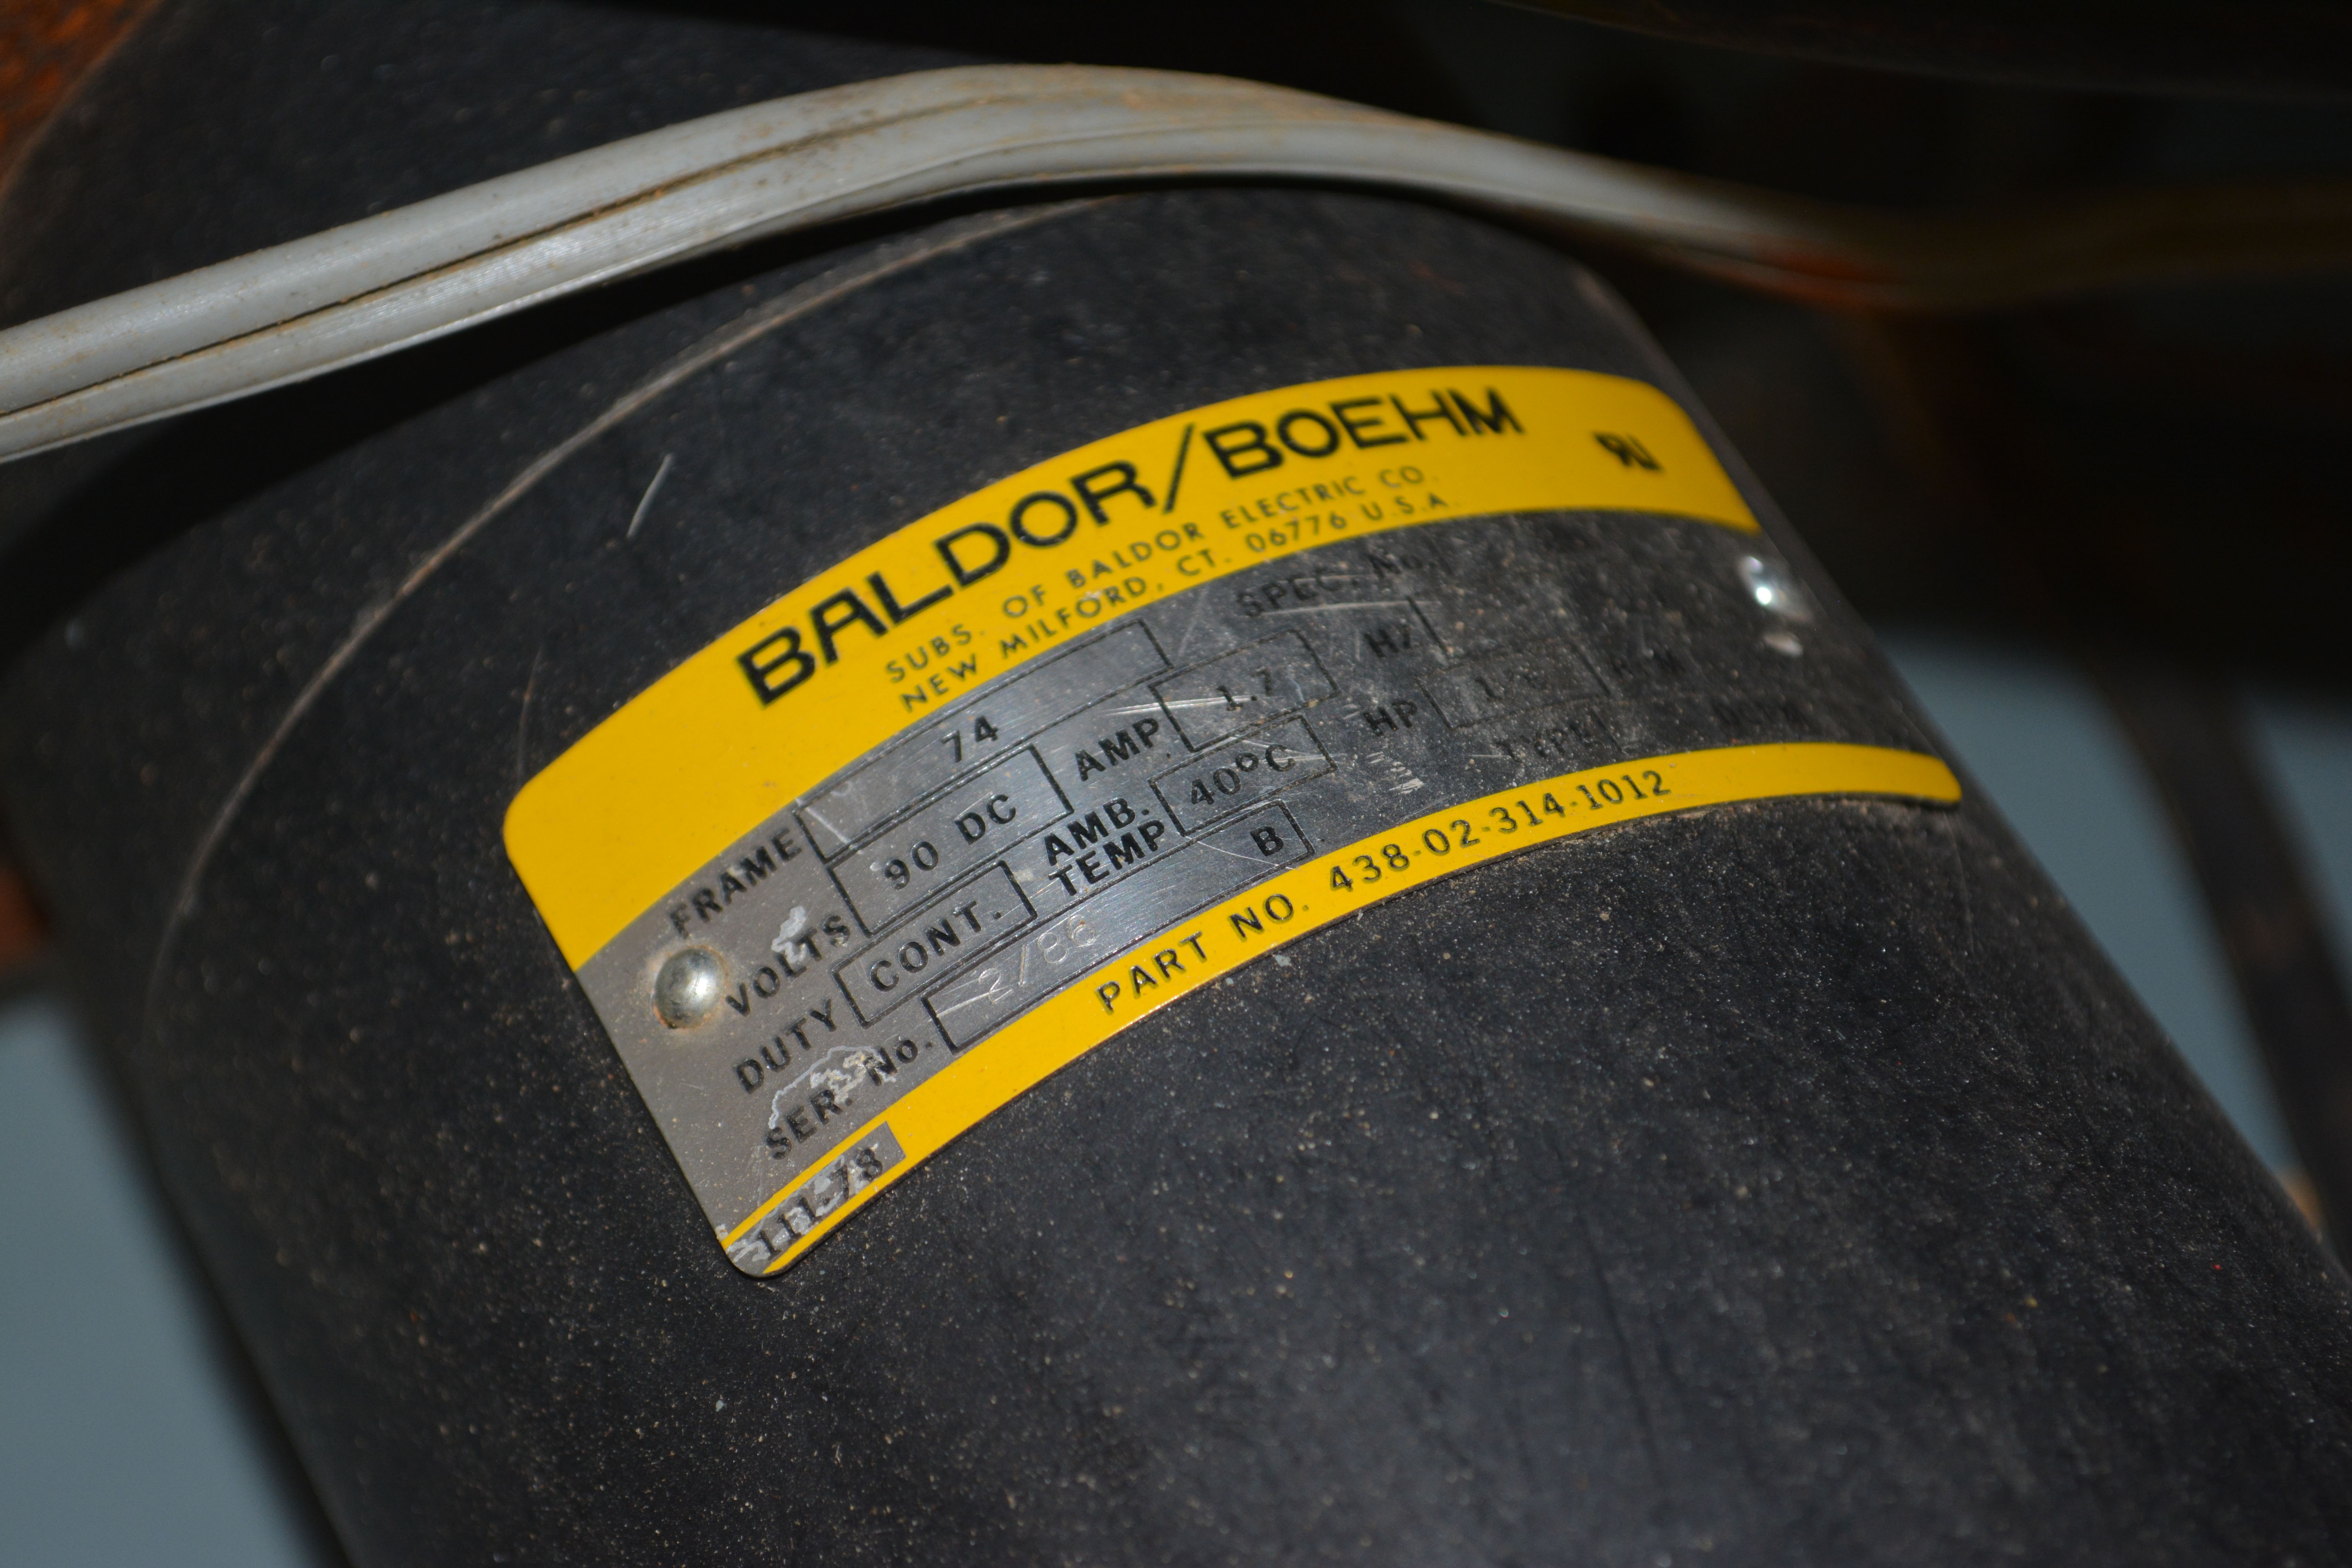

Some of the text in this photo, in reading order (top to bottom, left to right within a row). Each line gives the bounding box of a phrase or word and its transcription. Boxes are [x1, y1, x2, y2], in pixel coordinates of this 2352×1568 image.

[735, 386, 1526, 708] BALDOR/BOEHM
[885, 622, 985, 684] SUBS.
[1002, 583, 1049, 619] OF
[1065, 521, 1206, 589] BALDOR
[1220, 475, 1366, 530] ELECTRIC
[900, 653, 980, 712] NEW
[1176, 548, 1232, 579] CT.
[1245, 510, 1347, 553] 06776
[668, 715, 999, 939] FRAME 74
[724, 915, 851, 1017] VOLTS
[883, 840, 940, 890] 90
[953, 793, 1017, 845] DC
[1074, 716, 1160, 782] AMP
[1216, 668, 1274, 713] 1.7
[1047, 819, 1165, 897] TEMP
[1362, 699, 1418, 737] HP
[1250, 825, 1285, 857] B
[733, 796, 1150, 1094] DUTY CONT. AMB.
[1094, 931, 1209, 1015] PART
[1229, 893, 1310, 942] NO.
[765, 1037, 933, 1161] SER. No.
